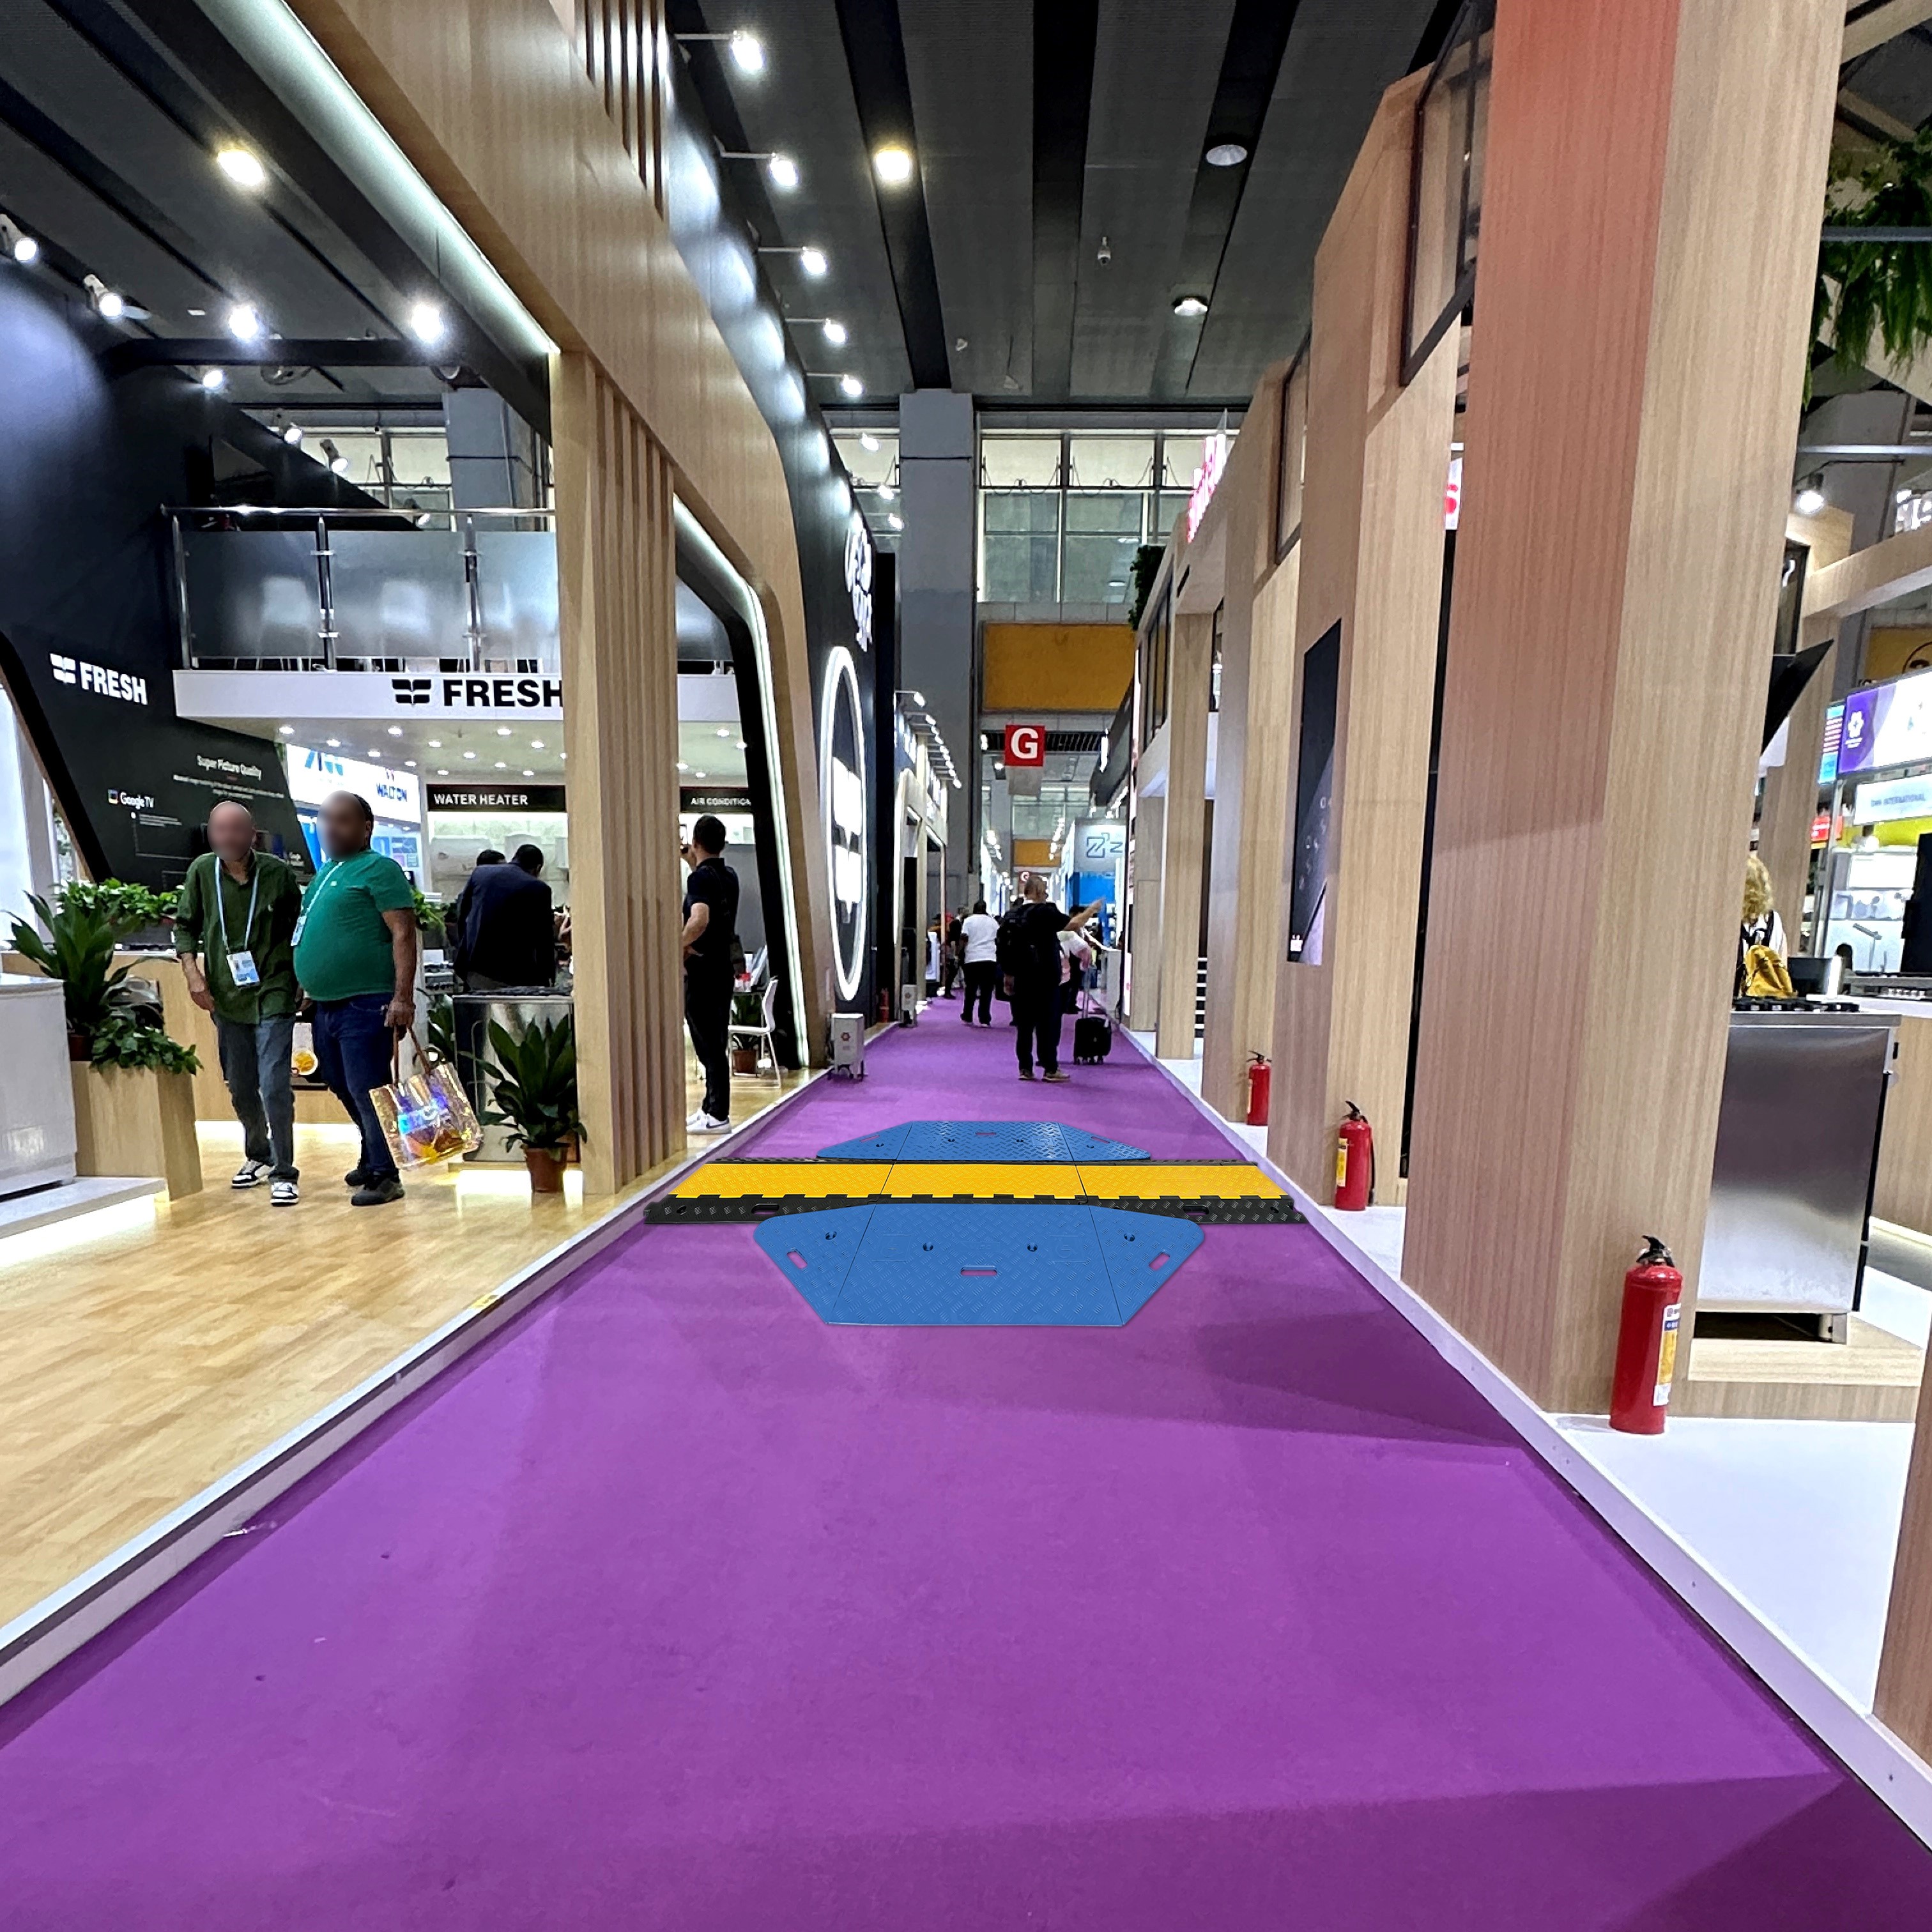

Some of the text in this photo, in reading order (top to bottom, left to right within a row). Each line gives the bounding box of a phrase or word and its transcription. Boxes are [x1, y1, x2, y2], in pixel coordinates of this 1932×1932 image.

[79, 661, 148, 705] FRESH
[443, 678, 563, 708] FRESH
[1011, 727, 1039, 759] G
[119, 791, 154, 810] Google TV
[433, 793, 529, 806] WATER HEATER
